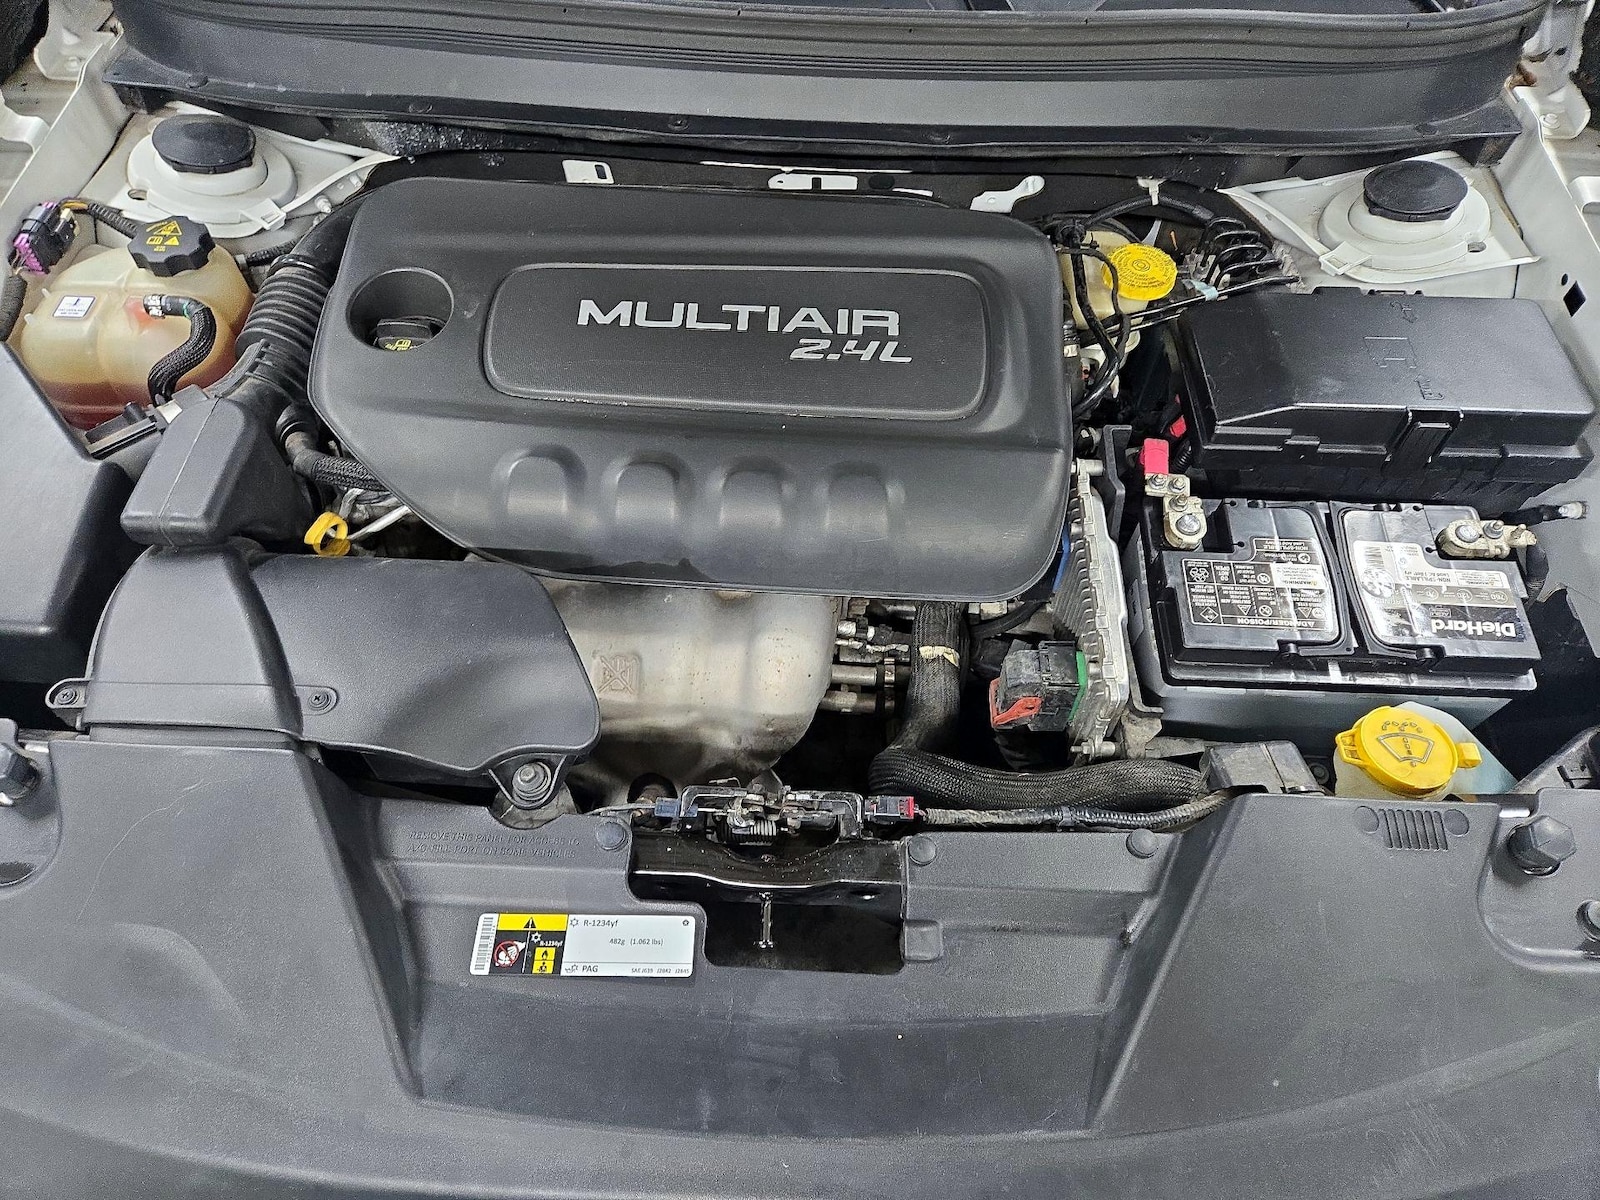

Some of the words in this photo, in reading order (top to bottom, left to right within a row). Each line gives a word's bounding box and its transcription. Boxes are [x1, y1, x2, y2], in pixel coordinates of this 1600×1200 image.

[577, 299, 899, 336] MULTIAIR
[790, 338, 912, 363] 2.4L
[1431, 619, 1516, 637] DieHard
[583, 919, 619, 928] R-1234yf
[609, 938, 626, 946] 482g
[630, 938, 650, 946] (1.062
[651, 938, 664, 946] lbs)
[581, 965, 599, 973] PAG
